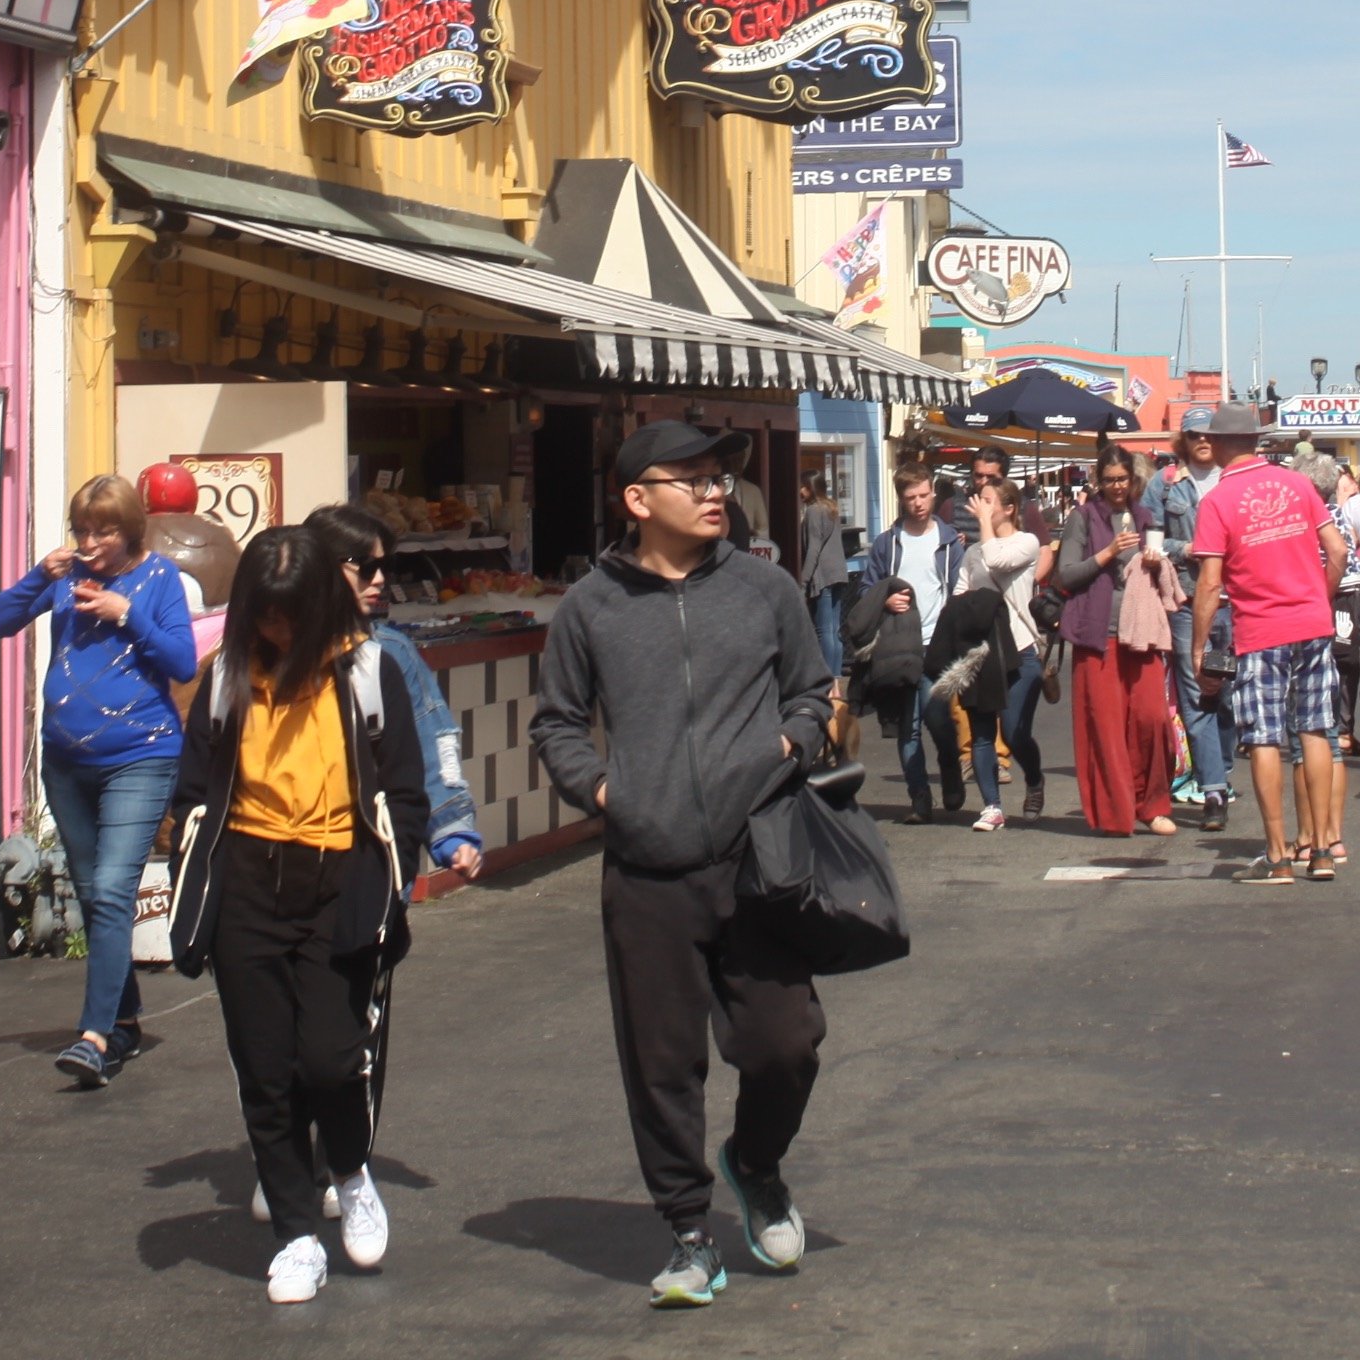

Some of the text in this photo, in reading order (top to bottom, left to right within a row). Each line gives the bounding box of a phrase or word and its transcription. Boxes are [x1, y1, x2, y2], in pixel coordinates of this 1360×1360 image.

[358, 23, 448, 82] GROTTO
[894, 114, 942, 131] BAY
[791, 163, 952, 186] ERS CRÊPES
[934, 244, 1062, 286] CAFE FINA
[1284, 411, 1345, 426] WHALE
[198, 483, 260, 543] 39
